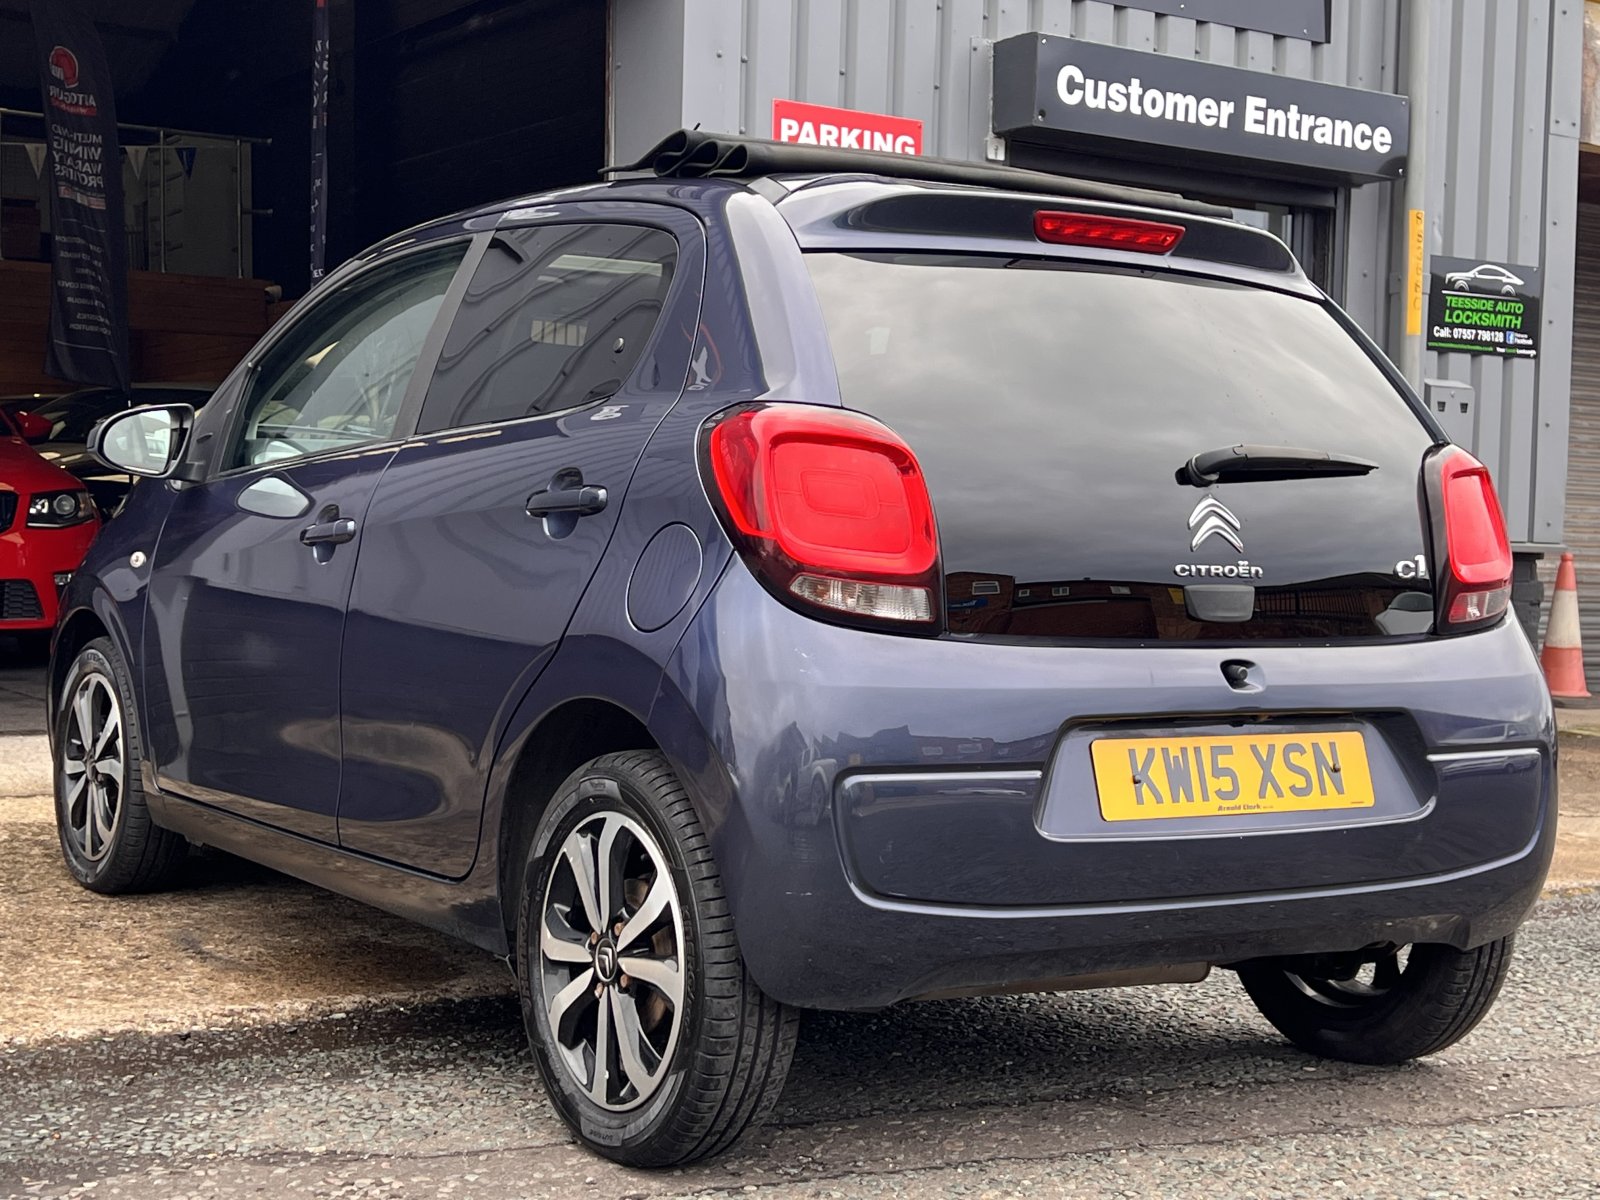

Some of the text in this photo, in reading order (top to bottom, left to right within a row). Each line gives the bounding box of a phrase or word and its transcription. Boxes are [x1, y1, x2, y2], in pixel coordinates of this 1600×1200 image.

[1056, 64, 1393, 155] Customer Entrance
[780, 117, 915, 156] PARKING
[1444, 309, 1522, 329] LOCKSMITH
[1445, 296, 1524, 314] TEESSIDE AUTO
[1433, 325, 1452, 338] Call:
[1452, 327, 1476, 340] 07557
[1128, 741, 1346, 806] KW15 XSN
